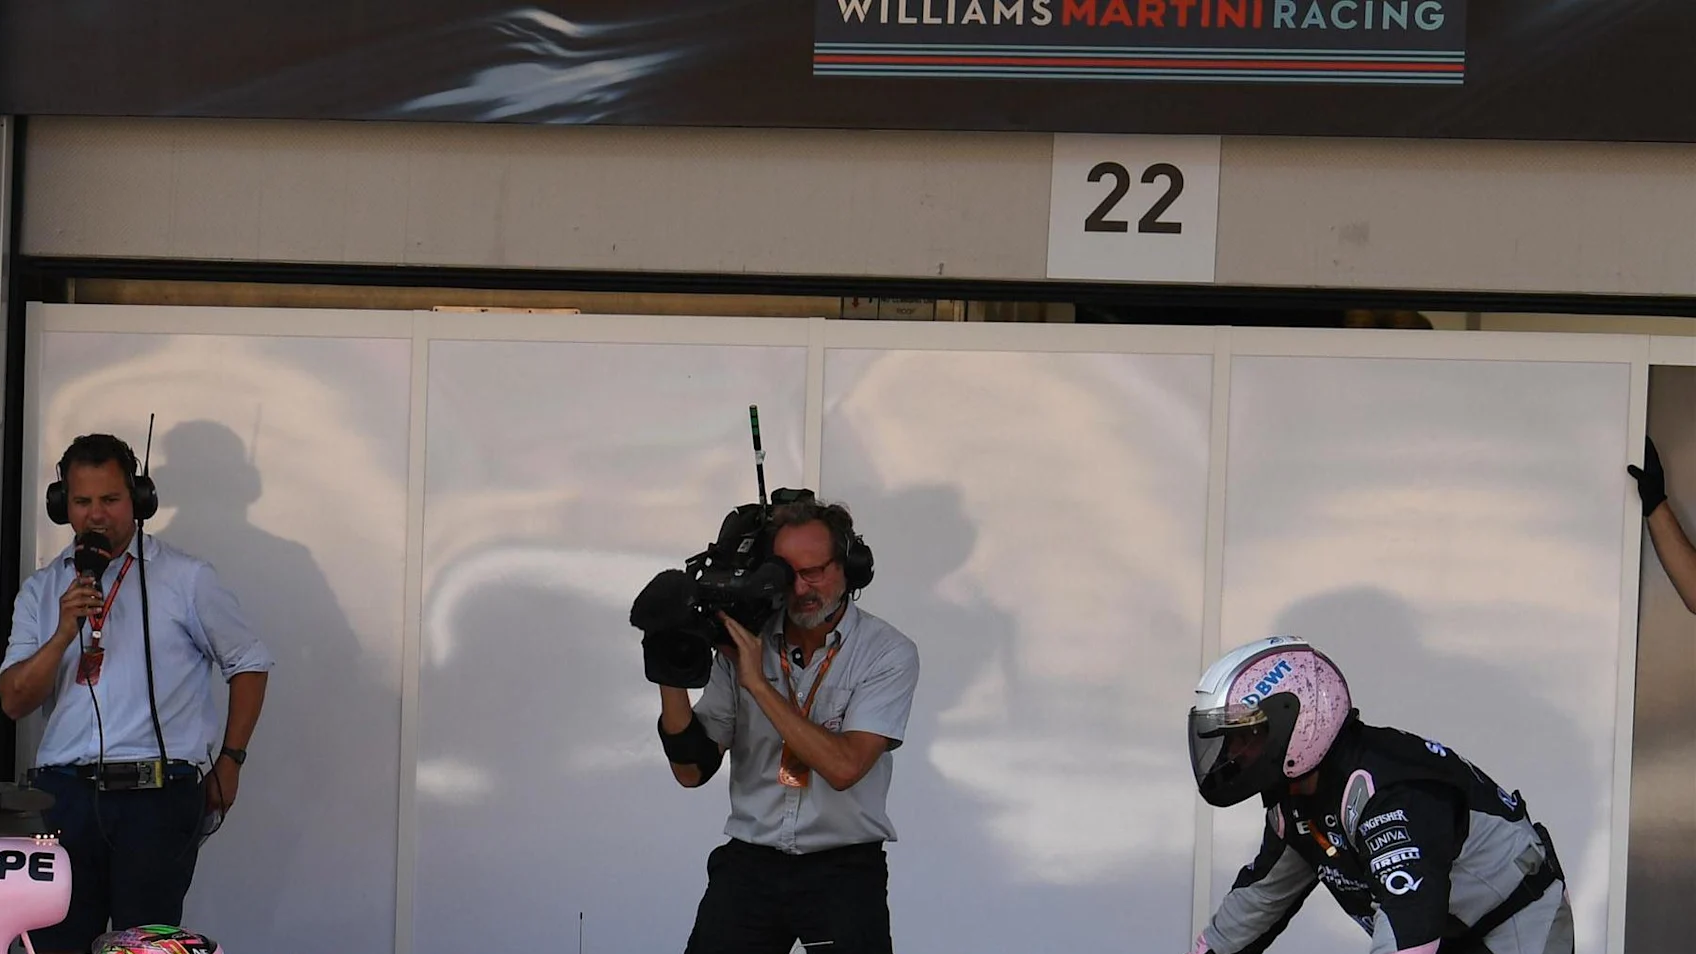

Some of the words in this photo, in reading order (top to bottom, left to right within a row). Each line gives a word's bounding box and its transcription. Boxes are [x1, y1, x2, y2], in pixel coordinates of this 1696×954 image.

[839, 0, 1052, 27] WILLIAMS
[1063, 0, 1263, 29] MARTINI
[1273, 0, 1445, 31] RACING
[1083, 162, 1185, 236] 22
[1254, 660, 1293, 696] BWT
[1369, 830, 1407, 852] UNIVA
[1370, 847, 1421, 874] PIRELLI
